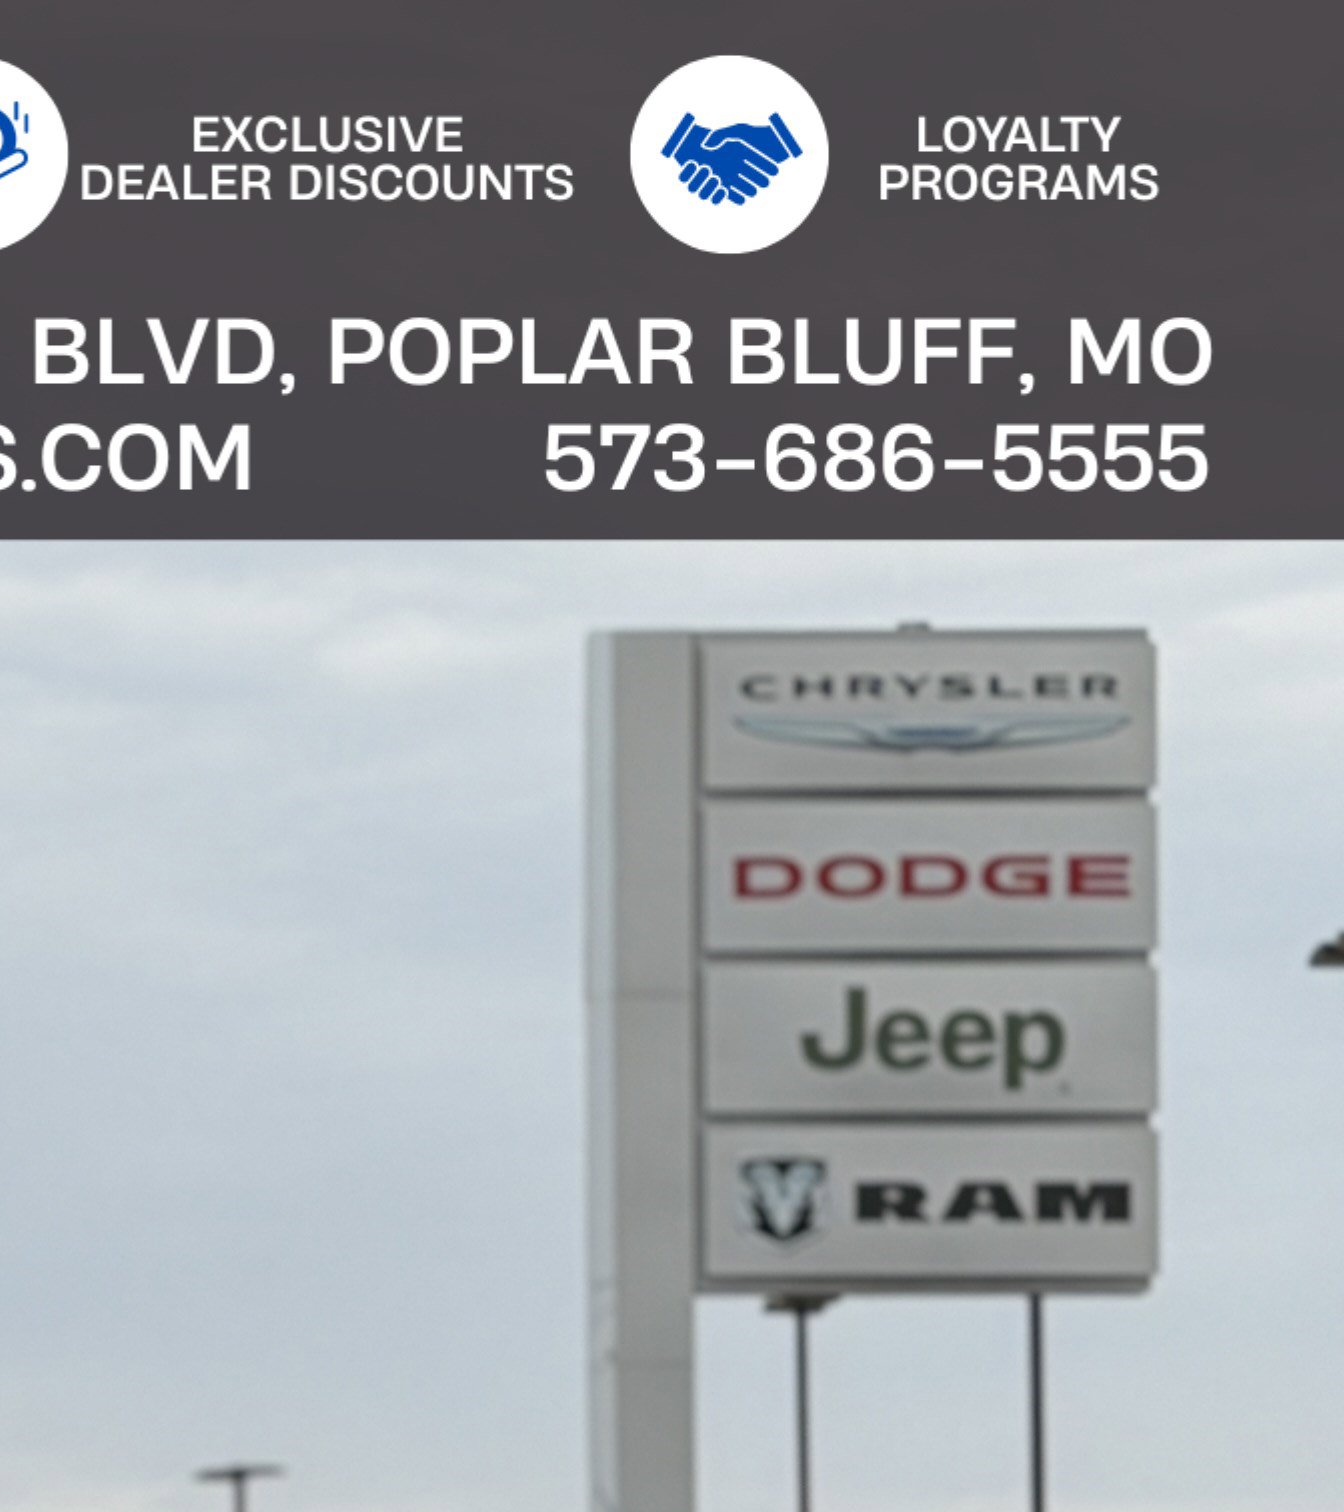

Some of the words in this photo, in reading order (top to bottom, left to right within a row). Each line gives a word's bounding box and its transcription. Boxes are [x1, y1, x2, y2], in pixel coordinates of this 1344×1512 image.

[739, 673, 1121, 703] CHRYSLER
[733, 855, 1132, 900] DODGE
[801, 985, 1065, 1091] Jeep
[855, 1182, 1133, 1224] RAM
